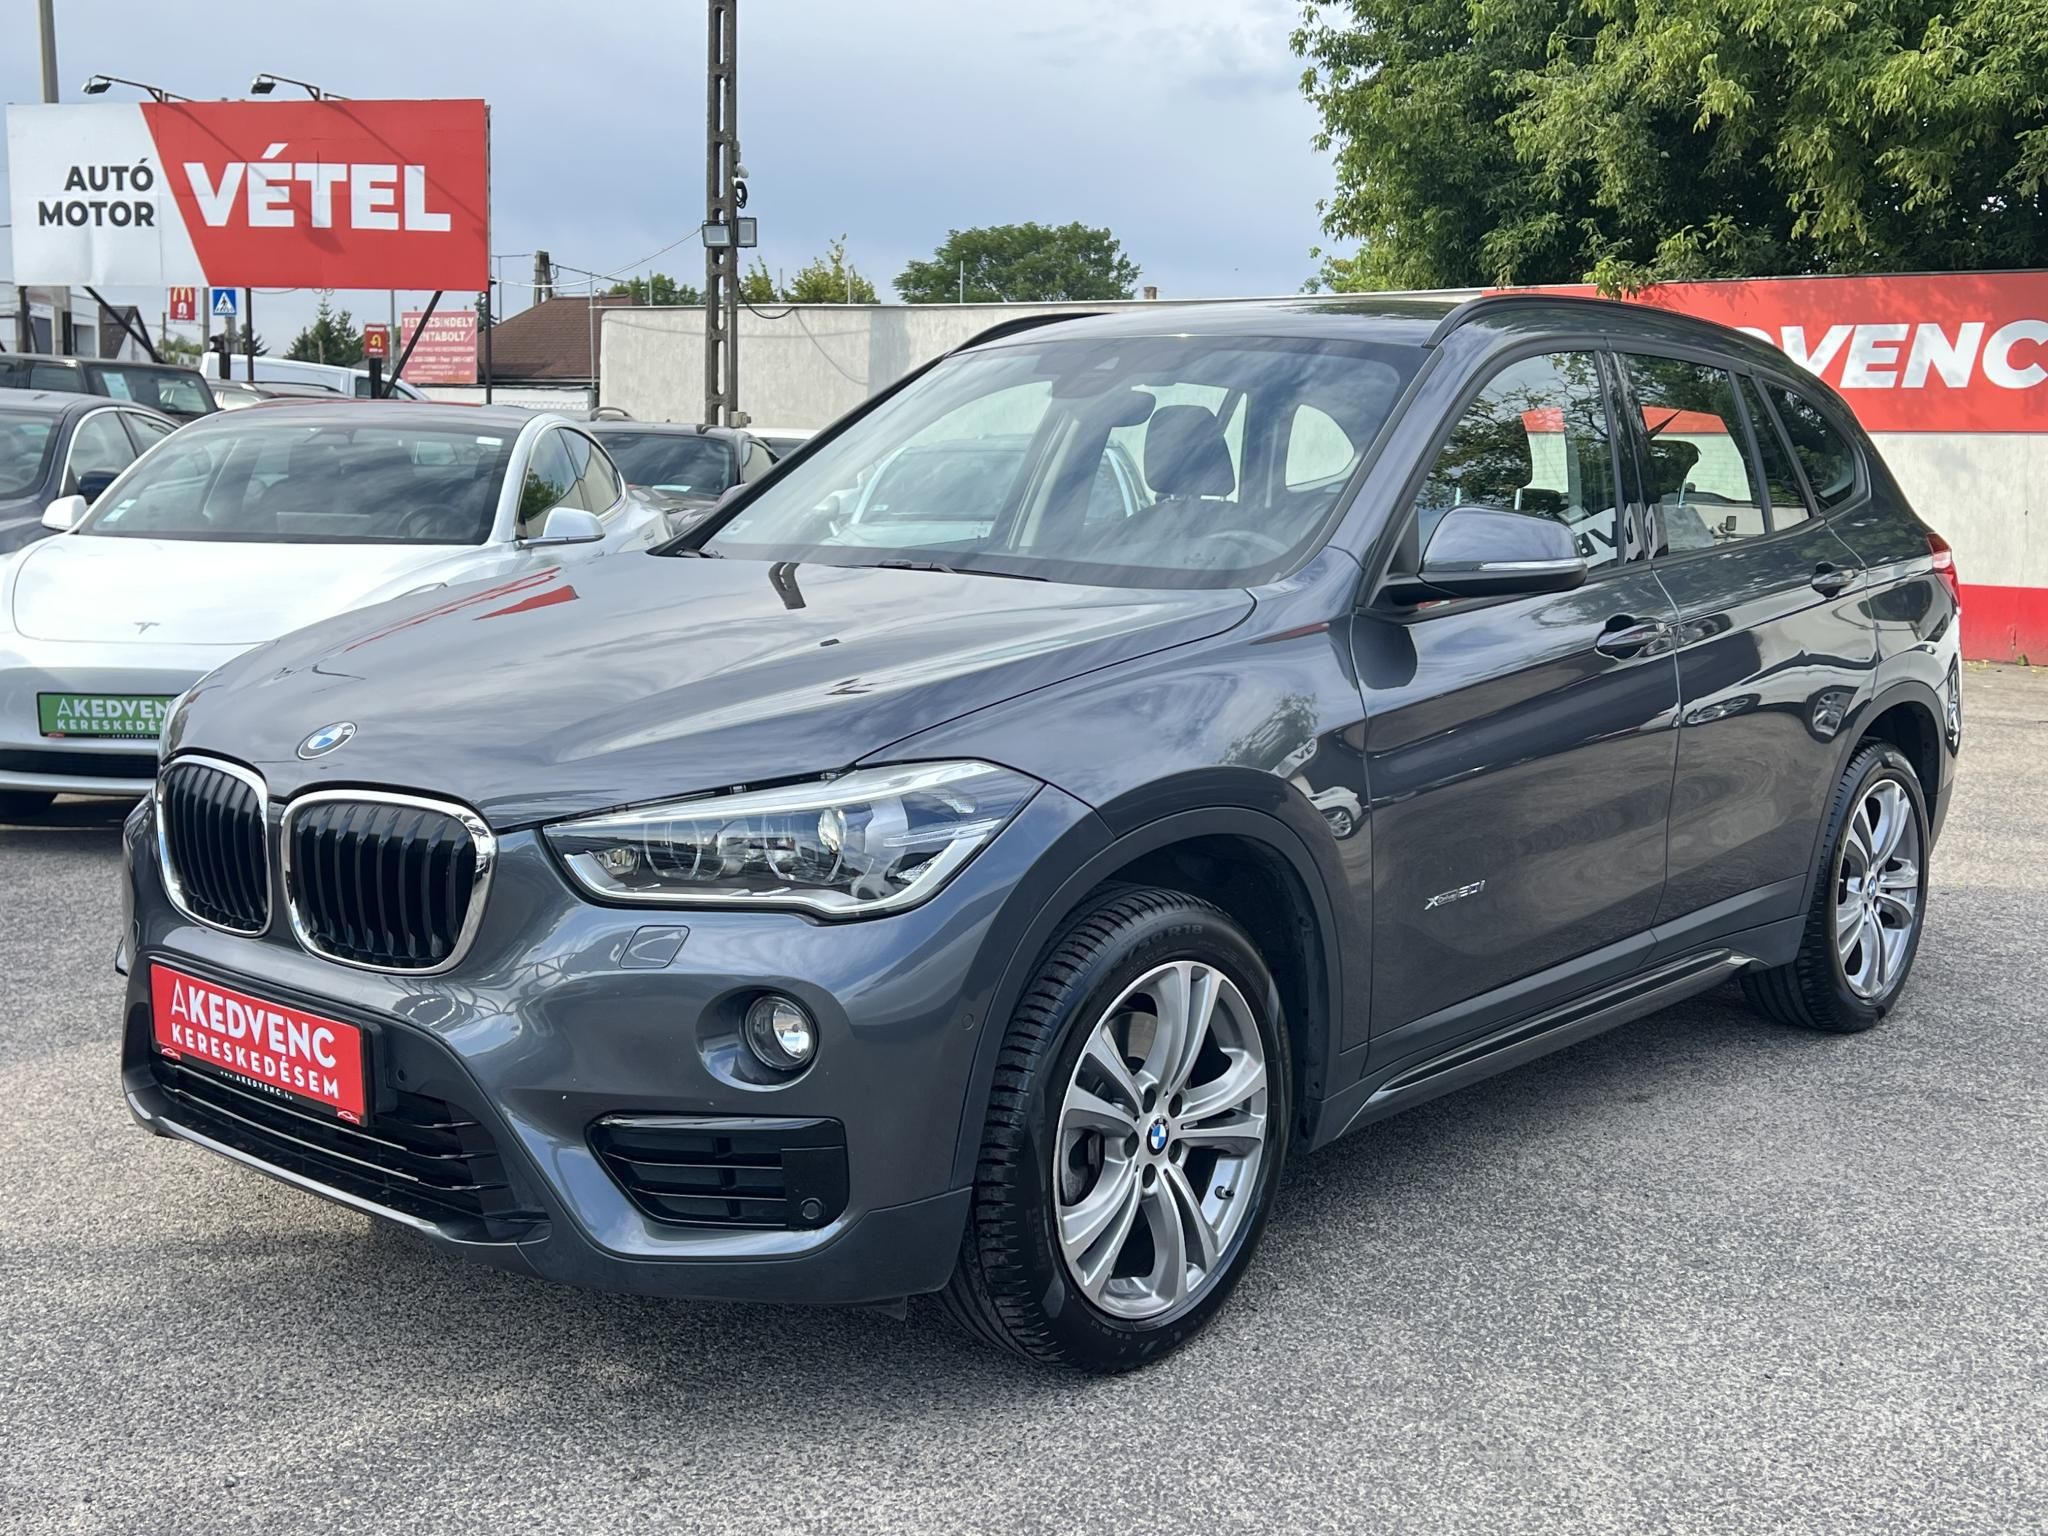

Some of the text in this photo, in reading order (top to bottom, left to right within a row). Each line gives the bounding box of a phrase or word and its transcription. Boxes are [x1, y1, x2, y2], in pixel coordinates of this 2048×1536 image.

[65, 157, 154, 191] AUTÓ
[183, 142, 451, 232] VÉTEL
[38, 201, 155, 226] MOTOR
[404, 317, 474, 328] TETZSINDELY
[57, 718, 163, 731] KERESKEDÉ
[171, 979, 337, 1069] AKEDVENC
[171, 1023, 339, 1099] KERESKEDÉSEM
